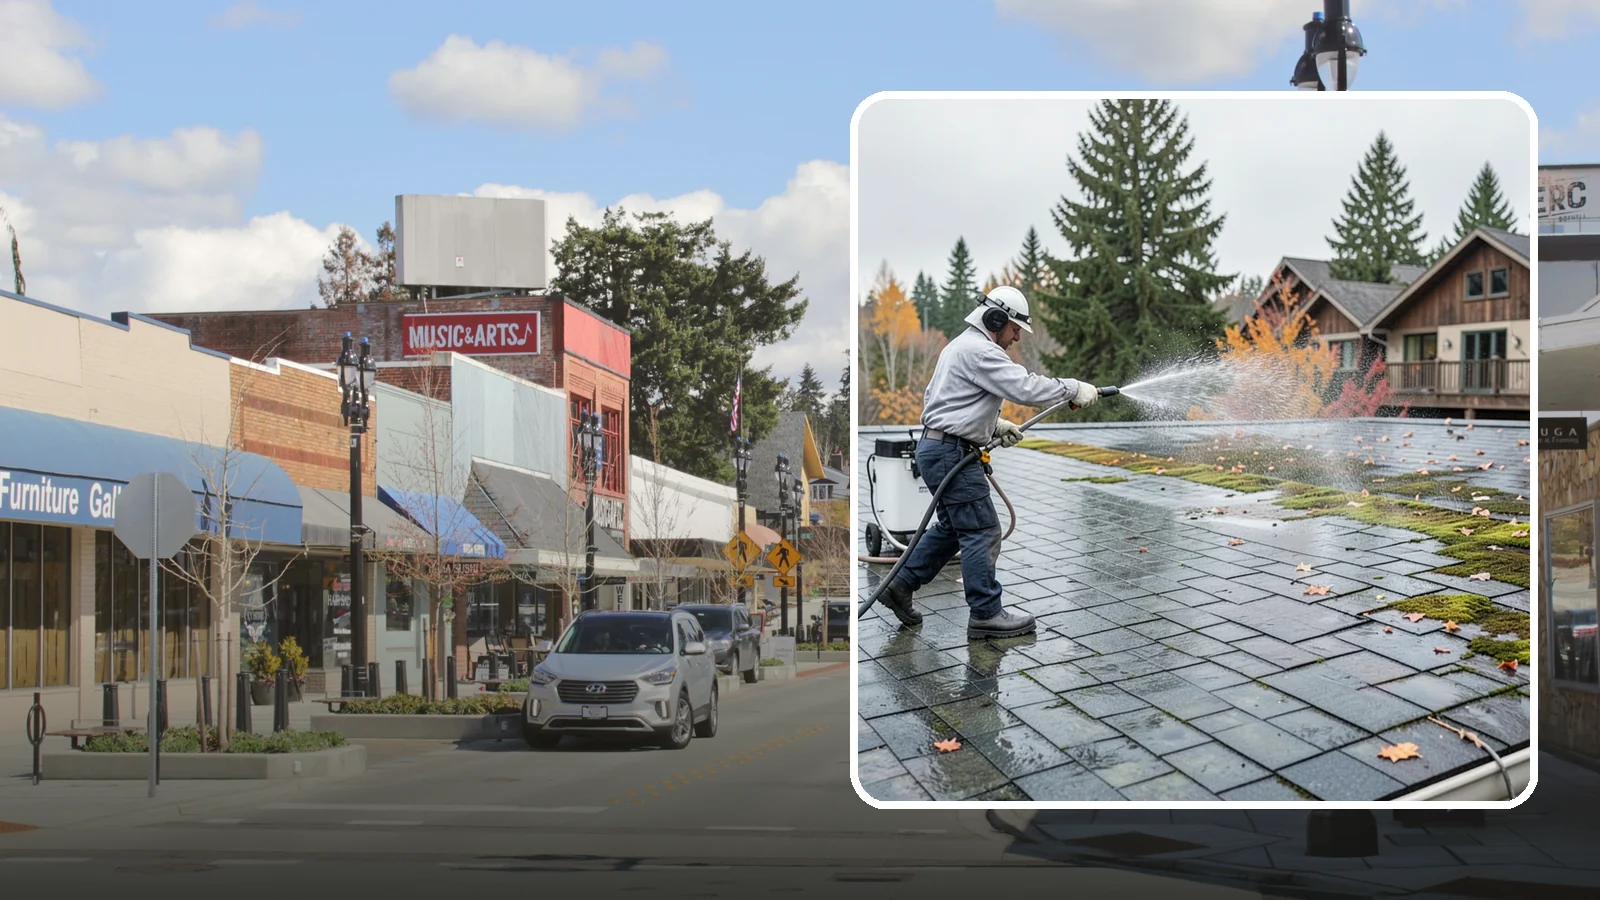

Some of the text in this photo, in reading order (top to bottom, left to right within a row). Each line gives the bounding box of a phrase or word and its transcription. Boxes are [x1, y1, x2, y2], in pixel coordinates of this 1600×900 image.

[0, 472, 122, 519] Furniture Gal
[453, 563, 479, 574] SUSHI
